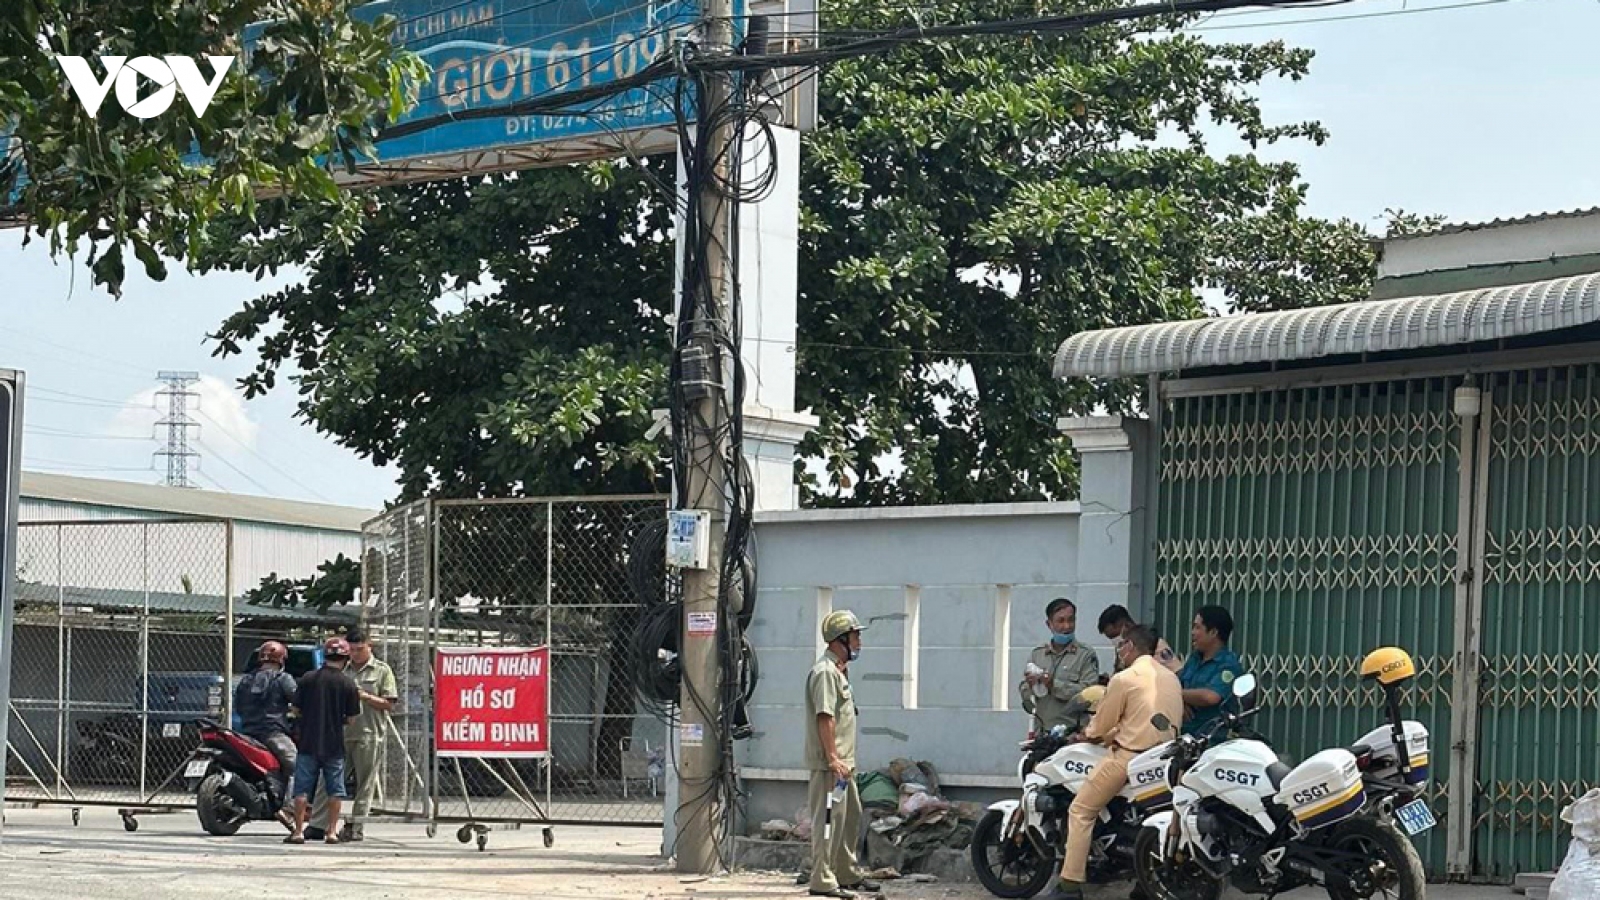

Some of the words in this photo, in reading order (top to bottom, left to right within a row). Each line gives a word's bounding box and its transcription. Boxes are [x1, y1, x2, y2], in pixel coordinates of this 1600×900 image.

[451, 4, 494, 29] NAM
[438, 37, 532, 107] GIỚI
[546, 24, 699, 93] 61-09
[506, 115, 536, 135] ĐT:
[497, 653, 542, 680] NHẬN
[490, 687, 516, 709] SƠ
[491, 722, 540, 747] ĐỊNH
[1137, 766, 1166, 783] CSG
[1214, 768, 1260, 786] CSGT
[1293, 782, 1330, 803] CSGT
